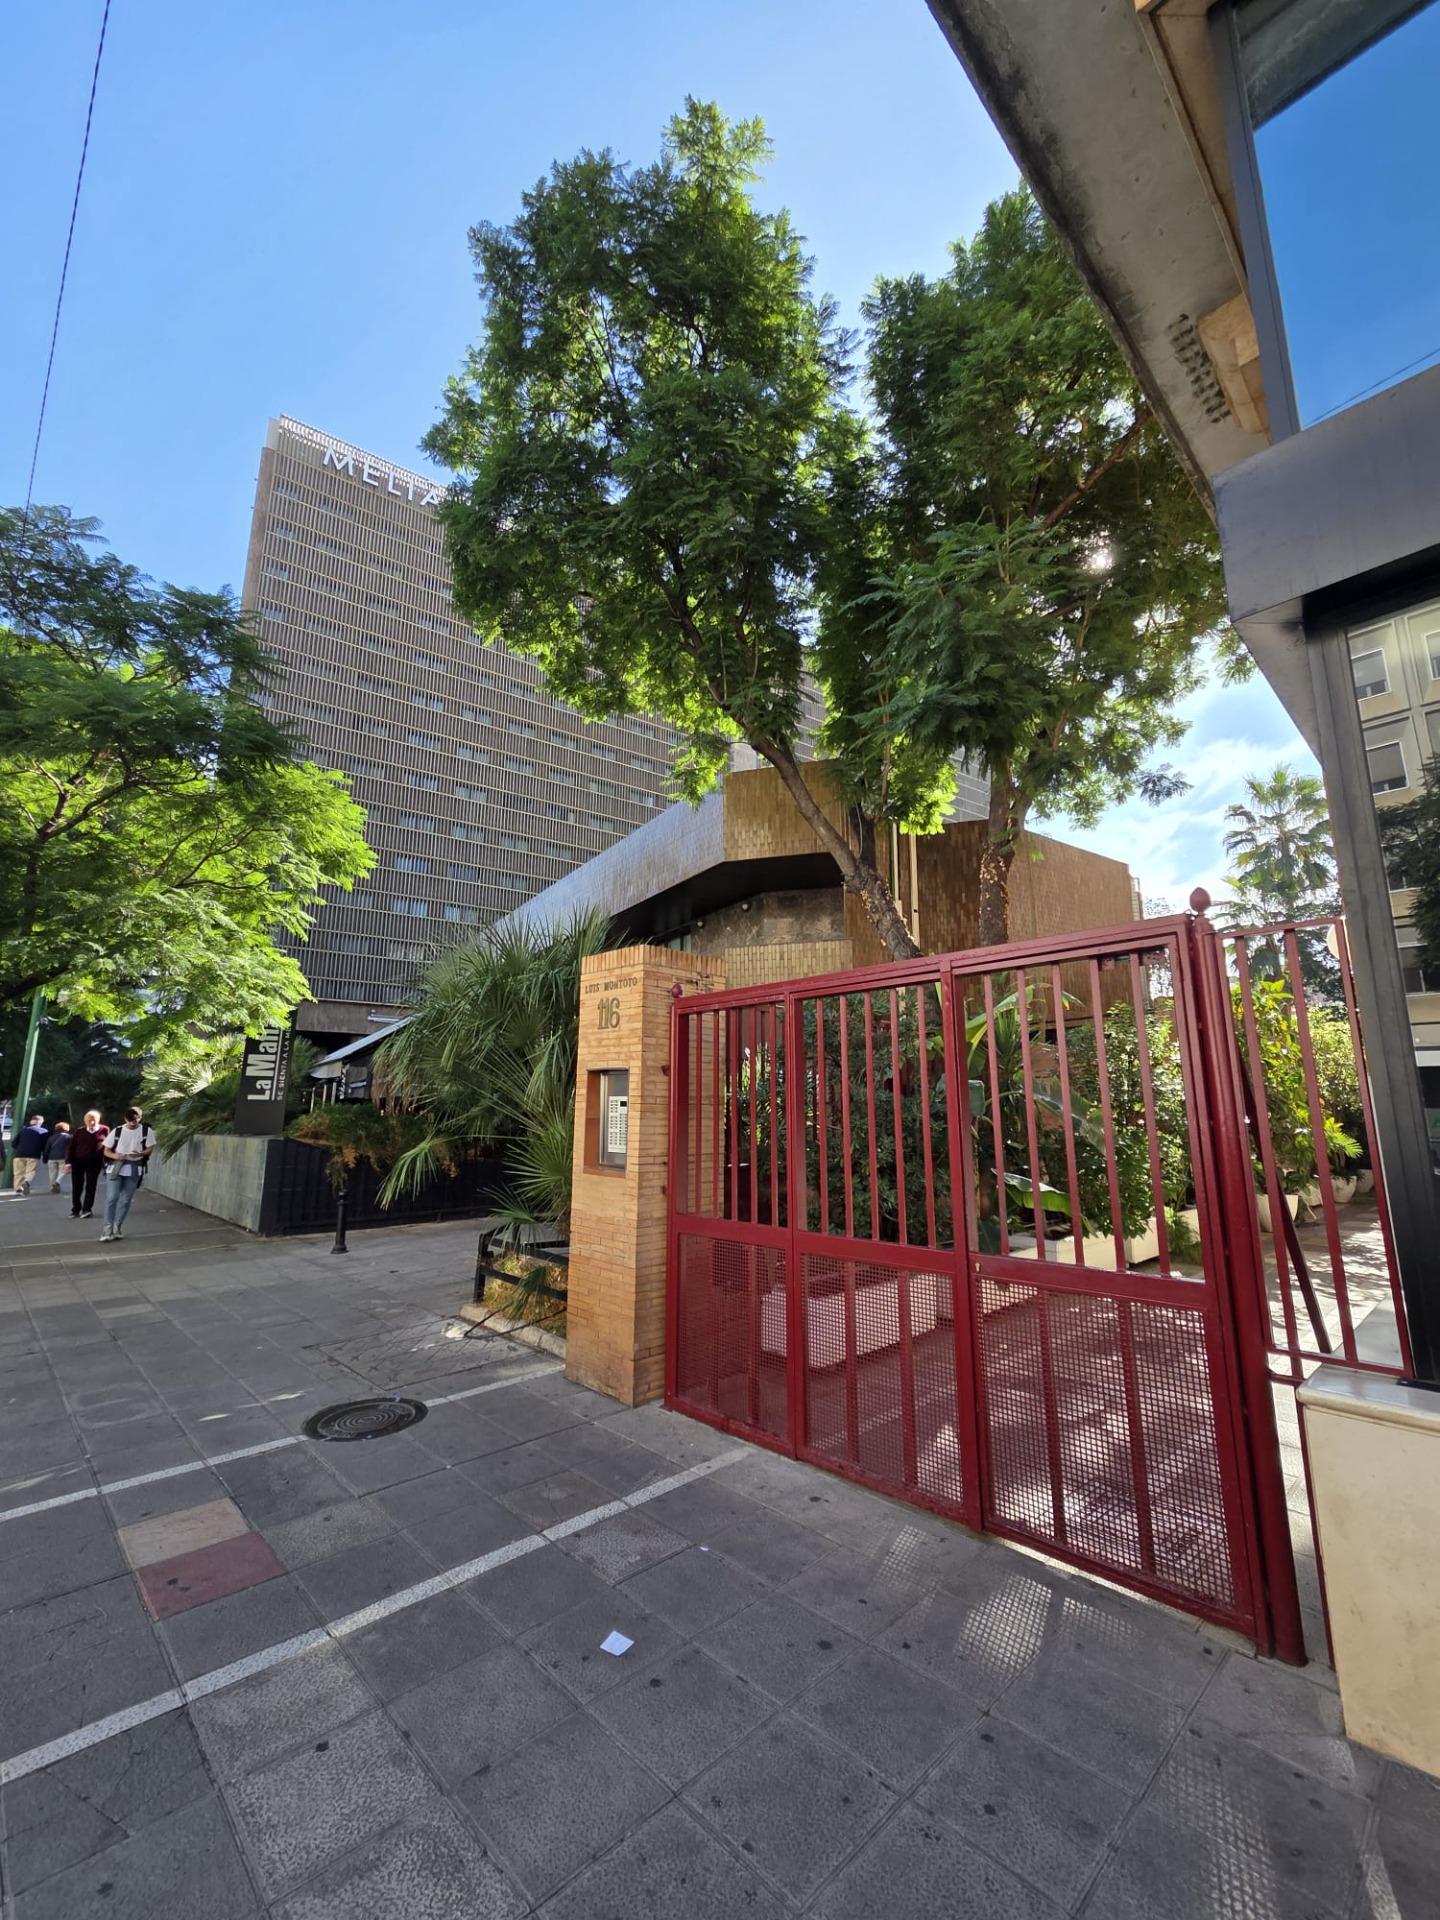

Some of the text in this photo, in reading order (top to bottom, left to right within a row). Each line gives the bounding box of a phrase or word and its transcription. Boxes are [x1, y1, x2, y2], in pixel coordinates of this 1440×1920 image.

[585, 978, 638, 994] LUIS MONTOTO
[597, 997, 620, 1030] 116
[279, 1060, 287, 1088] SIENTA
[284, 1041, 290, 1050] LA
[247, 1080, 271, 1100] La
